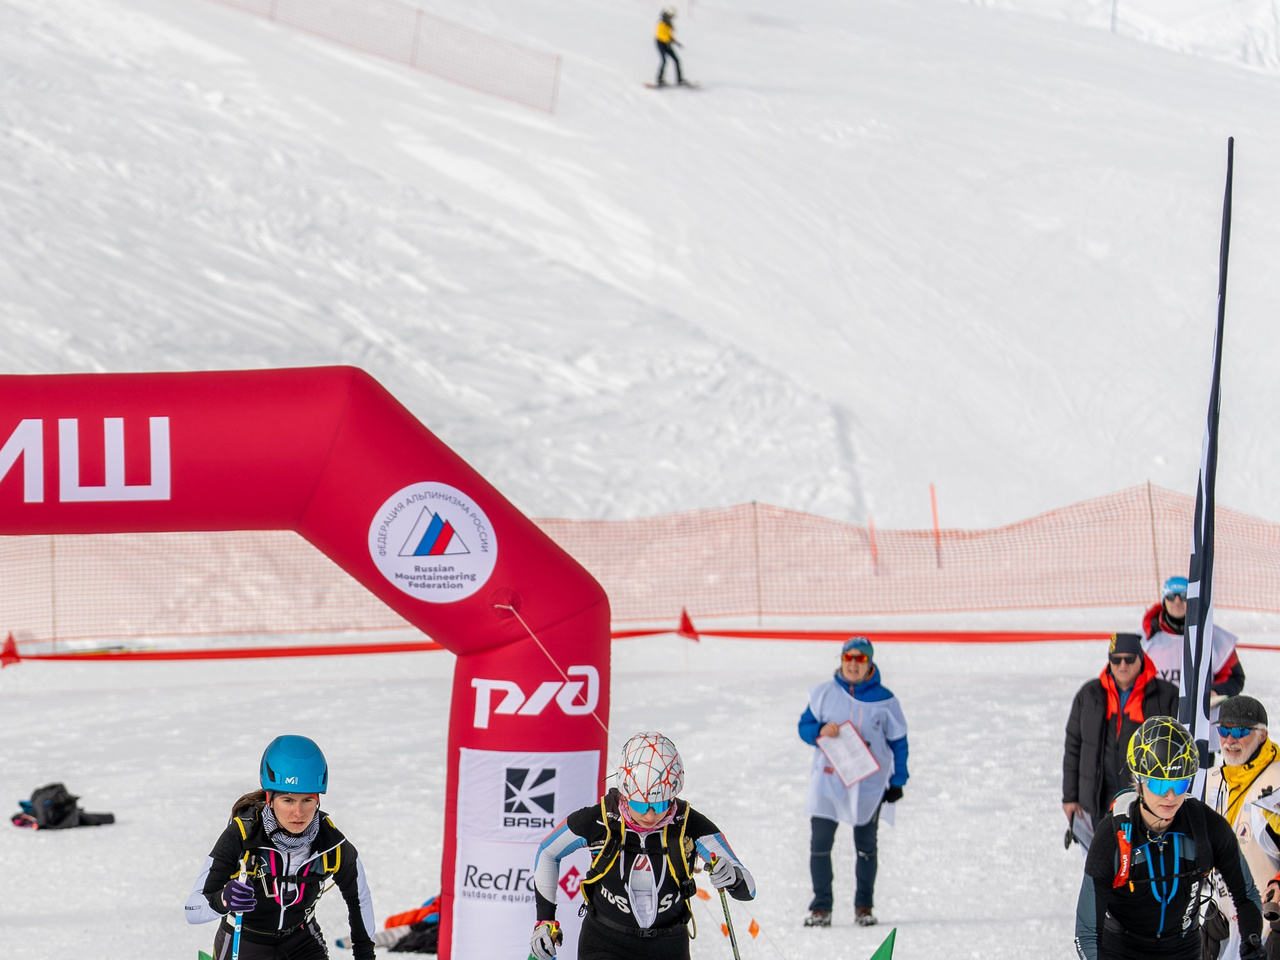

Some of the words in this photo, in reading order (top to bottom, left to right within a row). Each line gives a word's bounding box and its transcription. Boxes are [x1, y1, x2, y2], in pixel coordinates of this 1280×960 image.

[377, 502, 406, 557] ФЕДЕРАЦИЯ
[405, 491, 470, 515] АЛЬПИНИЗМА
[469, 512, 489, 553] РОССИИ
[414, 564, 455, 573] Russian
[394, 572, 477, 582] Mountaineering
[408, 581, 464, 589] Federation
[503, 817, 555, 828] BASK
[462, 890, 497, 900] outdoor
[502, 893, 536, 904] equip
